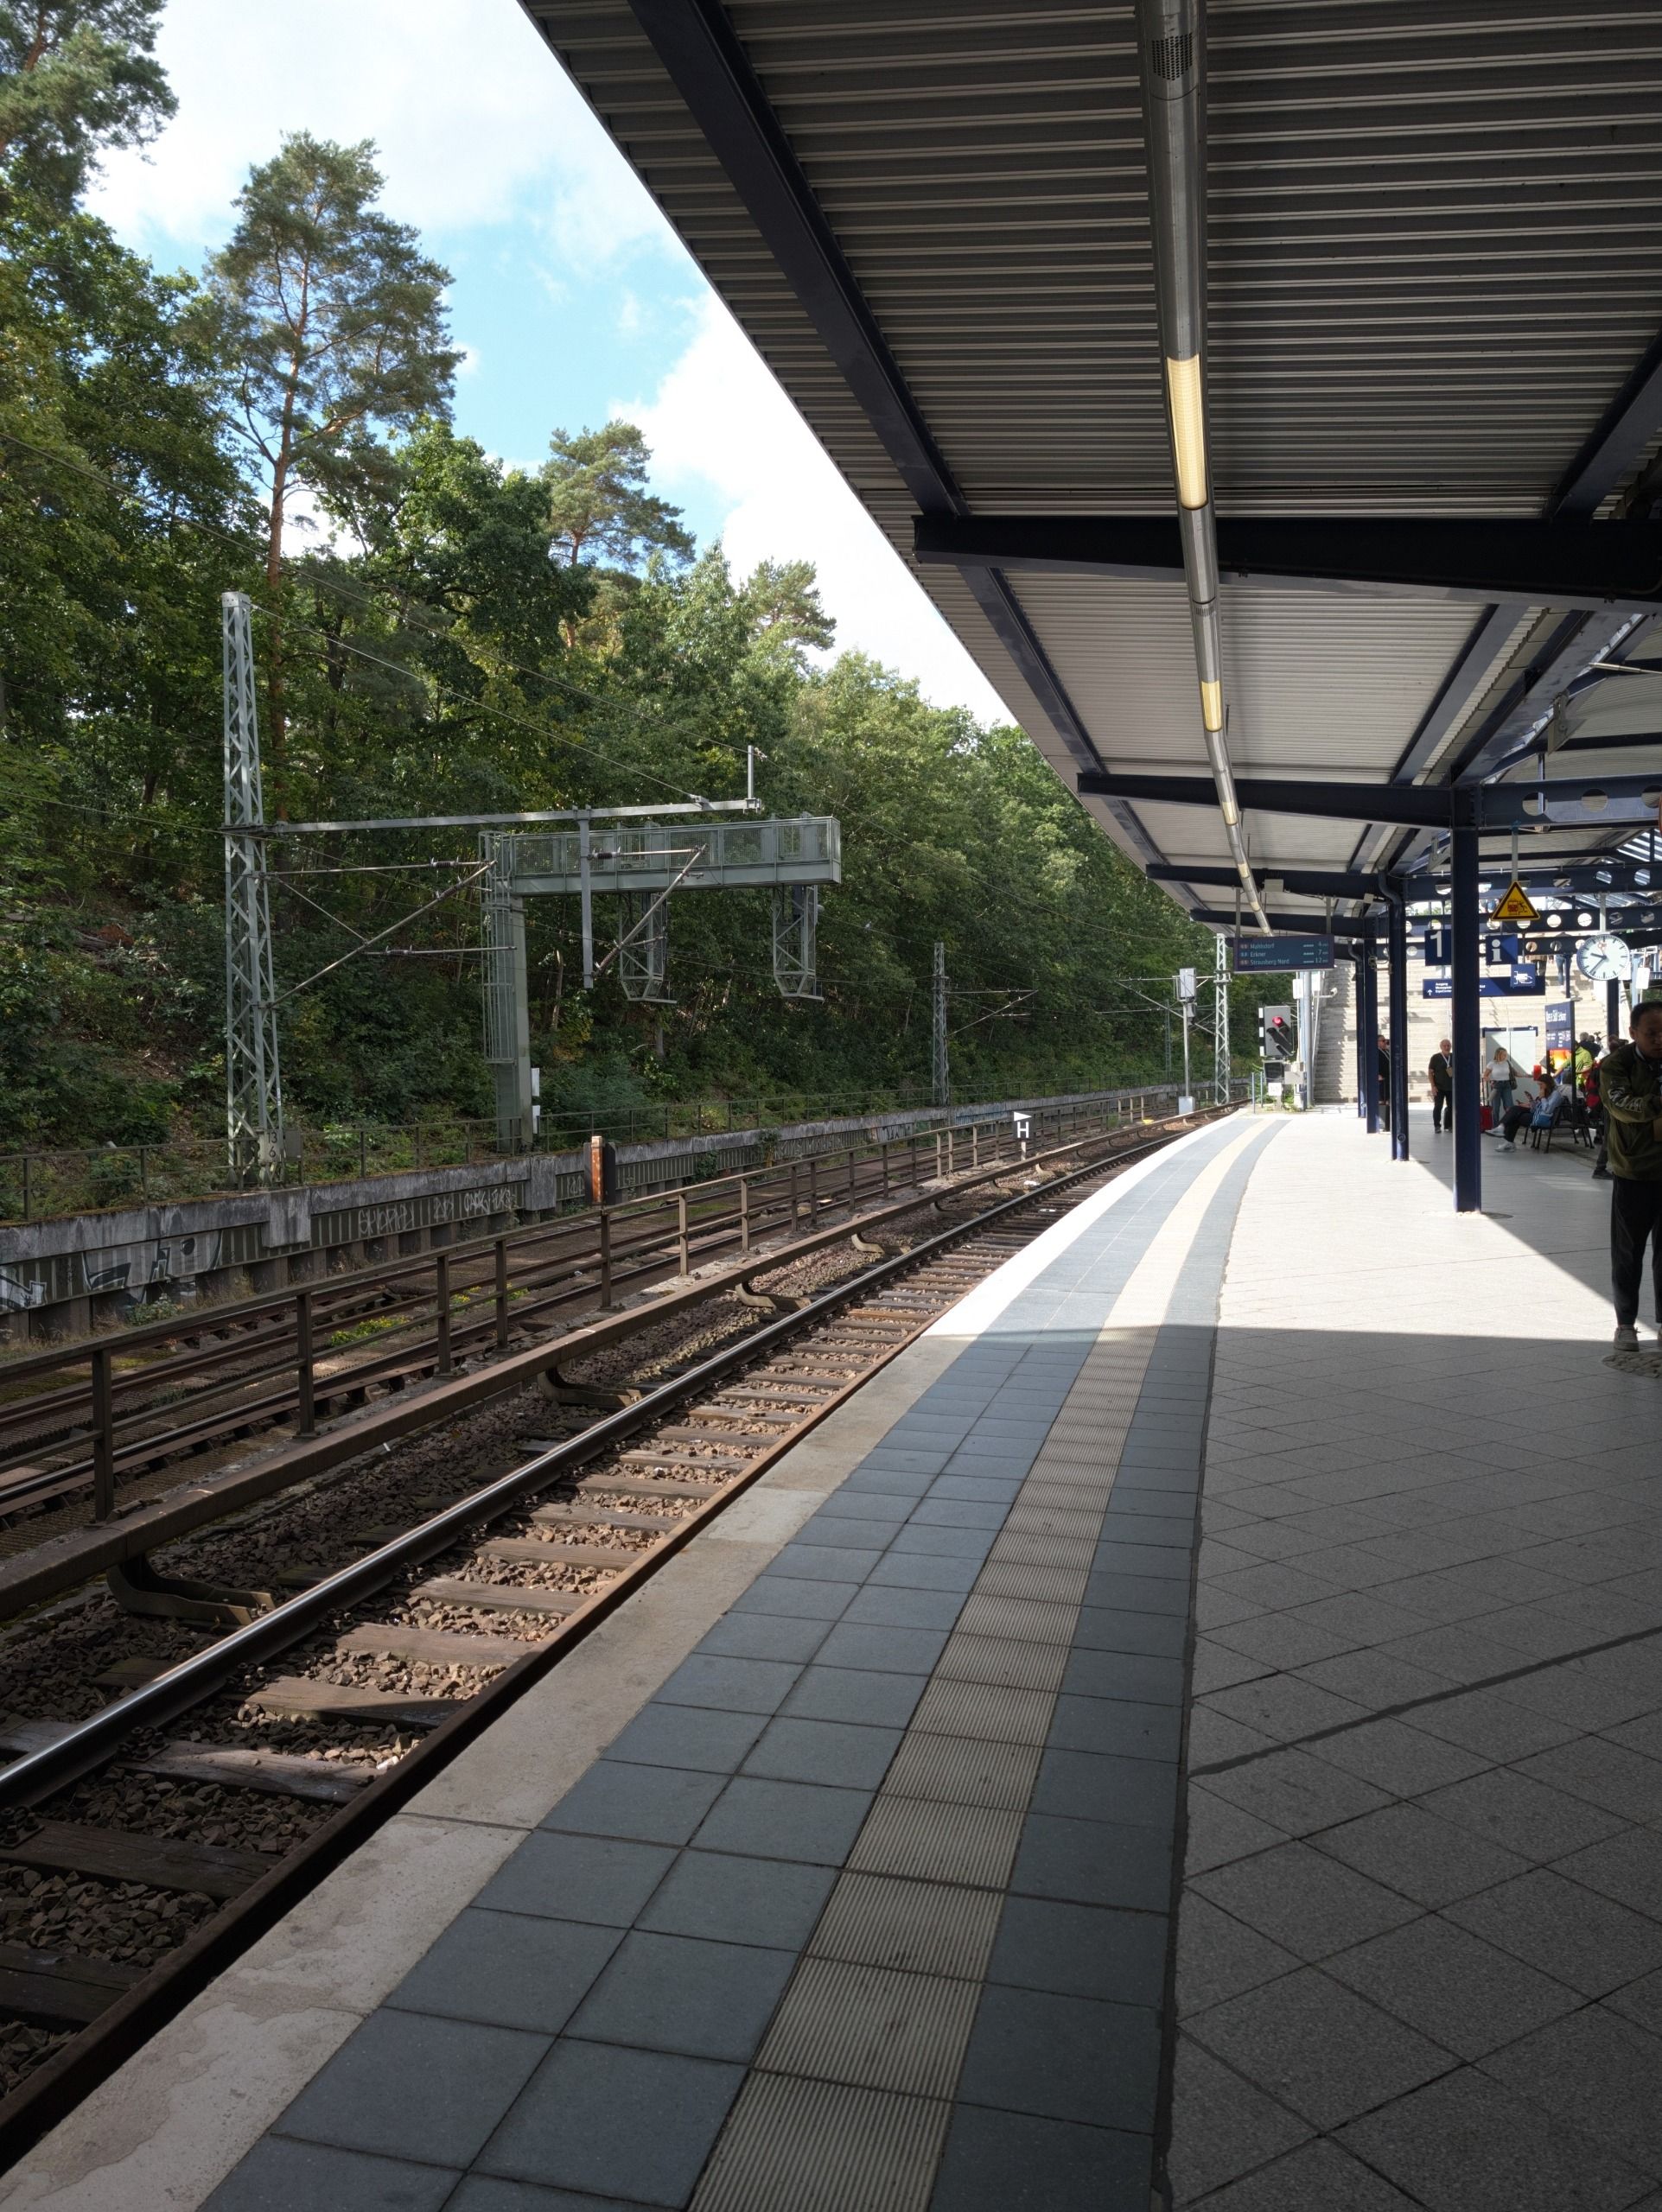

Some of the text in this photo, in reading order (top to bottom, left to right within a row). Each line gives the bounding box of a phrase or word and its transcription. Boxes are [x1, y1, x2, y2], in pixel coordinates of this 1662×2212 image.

[1430, 931, 1442, 957] 1
[1017, 1122, 1029, 1138] H
[267, 1132, 277, 1143] 13
[270, 1146, 277, 1158] 6
